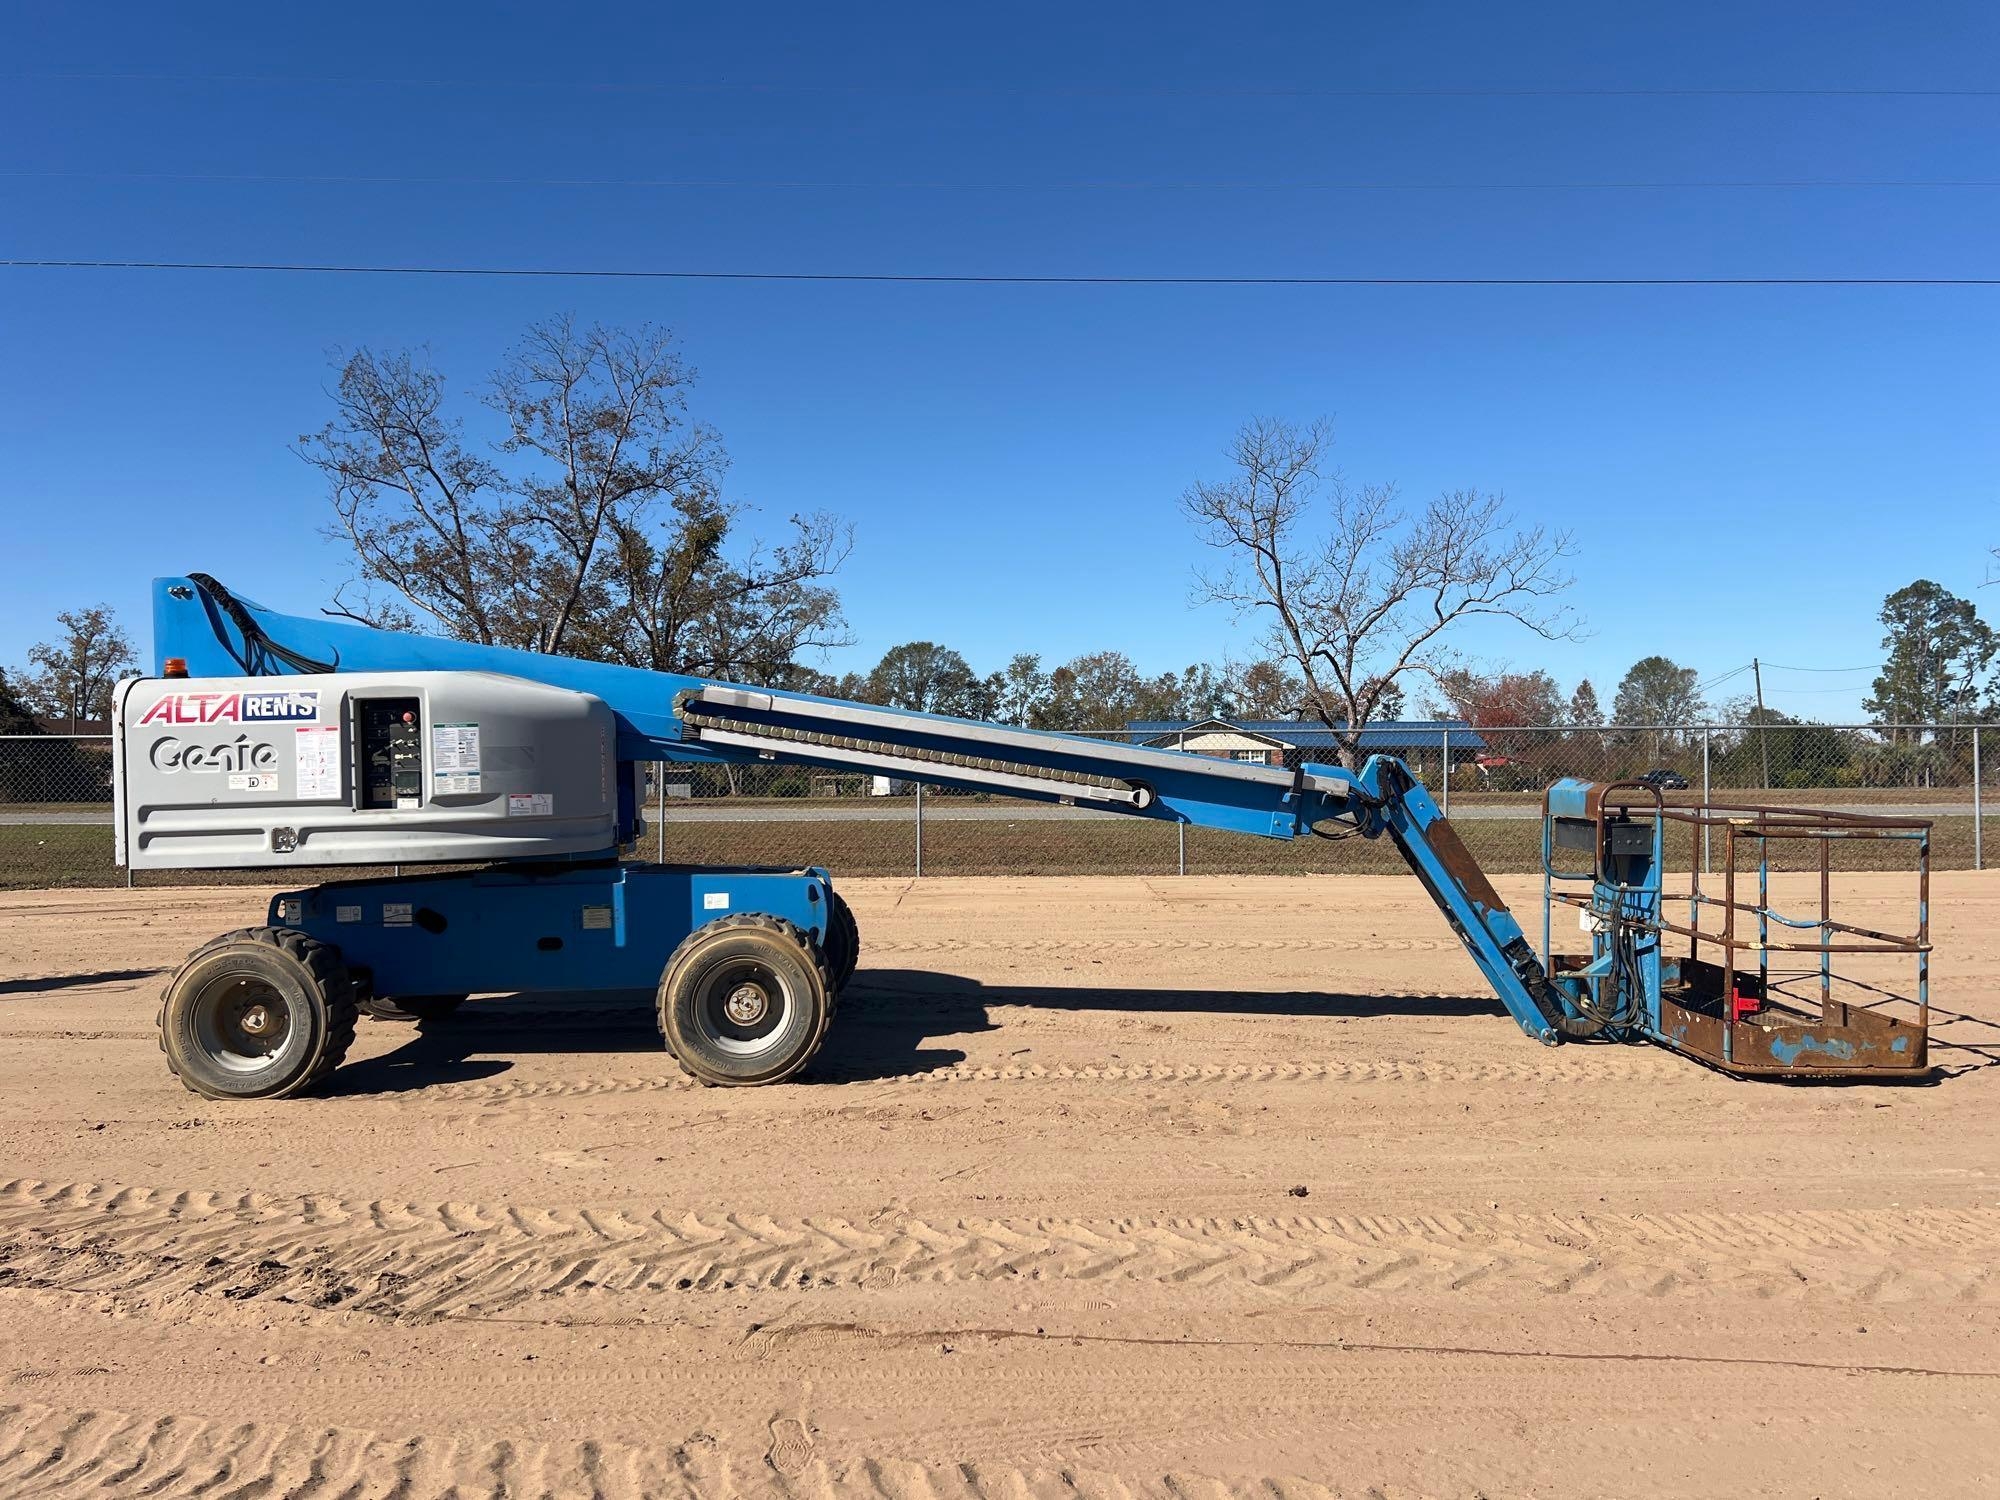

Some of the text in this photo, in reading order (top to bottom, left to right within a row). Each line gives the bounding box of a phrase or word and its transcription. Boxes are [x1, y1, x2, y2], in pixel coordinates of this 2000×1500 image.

[140, 694, 314, 725] ALTA RENTS
[150, 733, 279, 774] Genie
